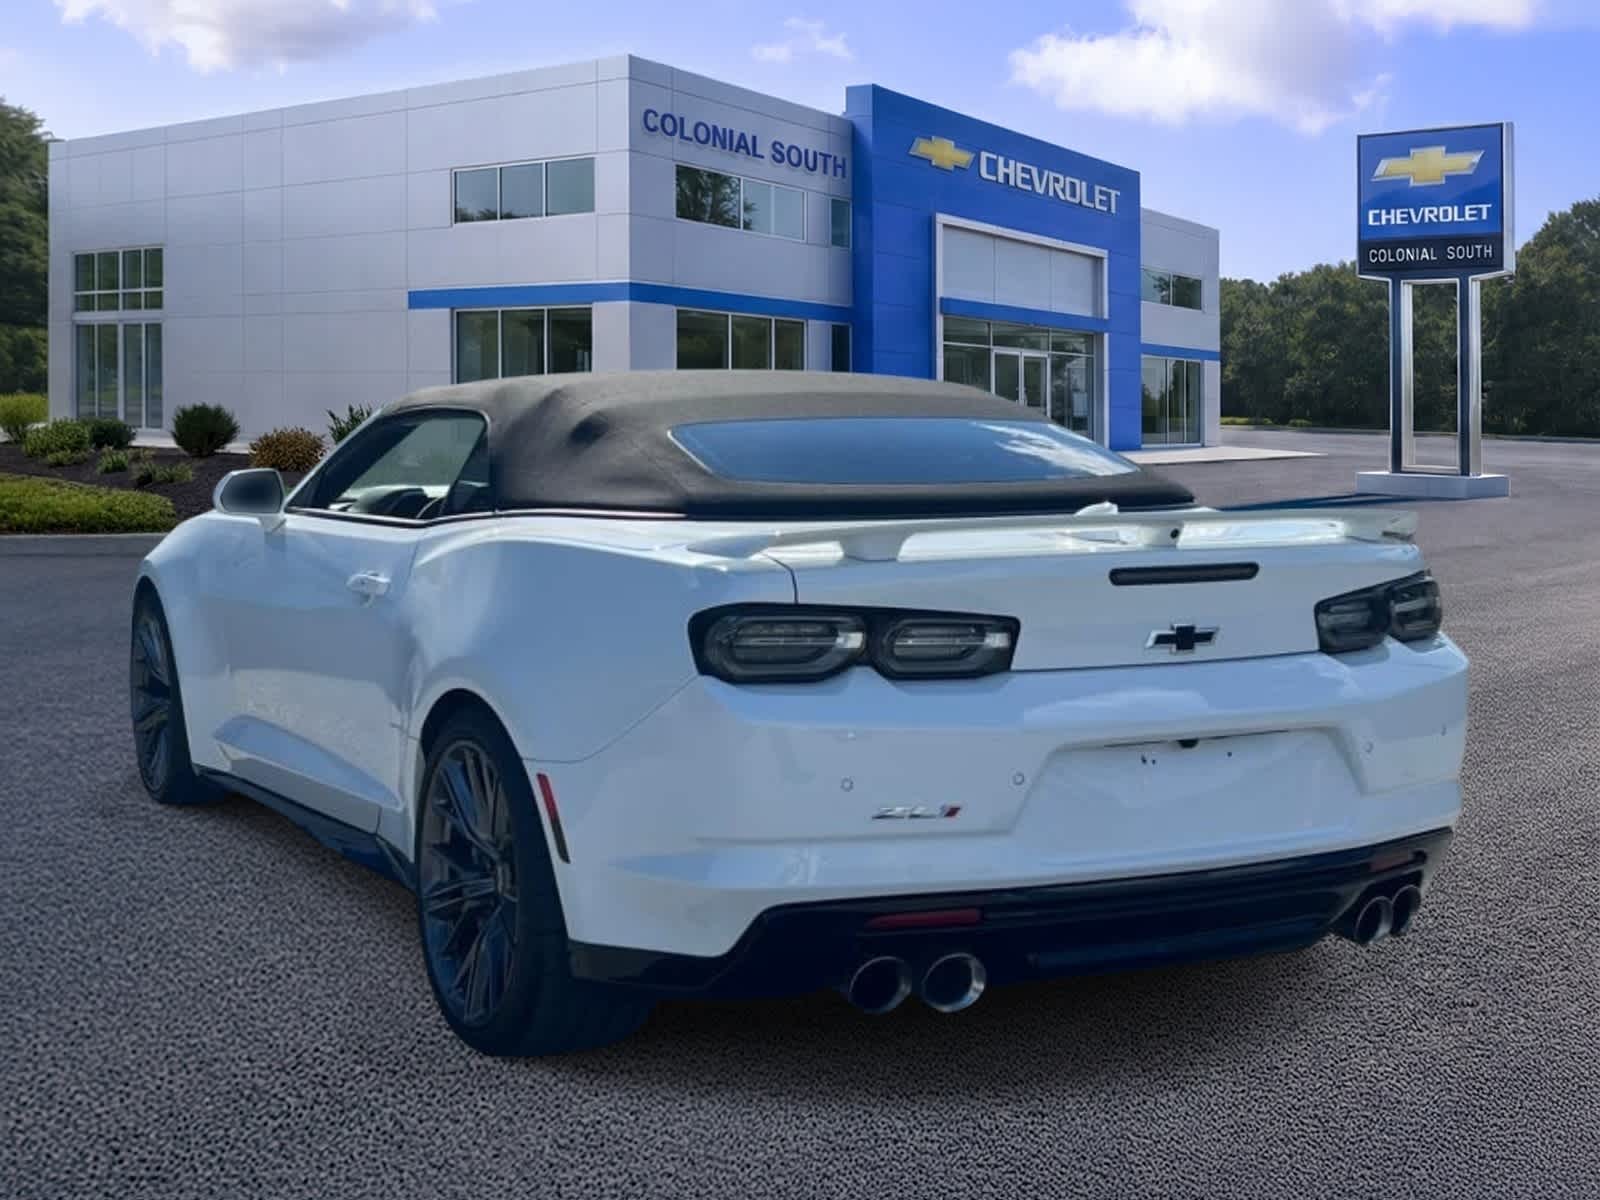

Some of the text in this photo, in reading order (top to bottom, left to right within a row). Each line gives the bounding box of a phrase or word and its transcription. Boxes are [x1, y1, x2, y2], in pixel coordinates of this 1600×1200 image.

[642, 108, 847, 179] COLONIAL SOUTH
[978, 151, 1121, 214] CHEVROLET
[1368, 203, 1492, 226] CHEVROLET
[1369, 245, 1492, 263] COLONIAL SOUTH
